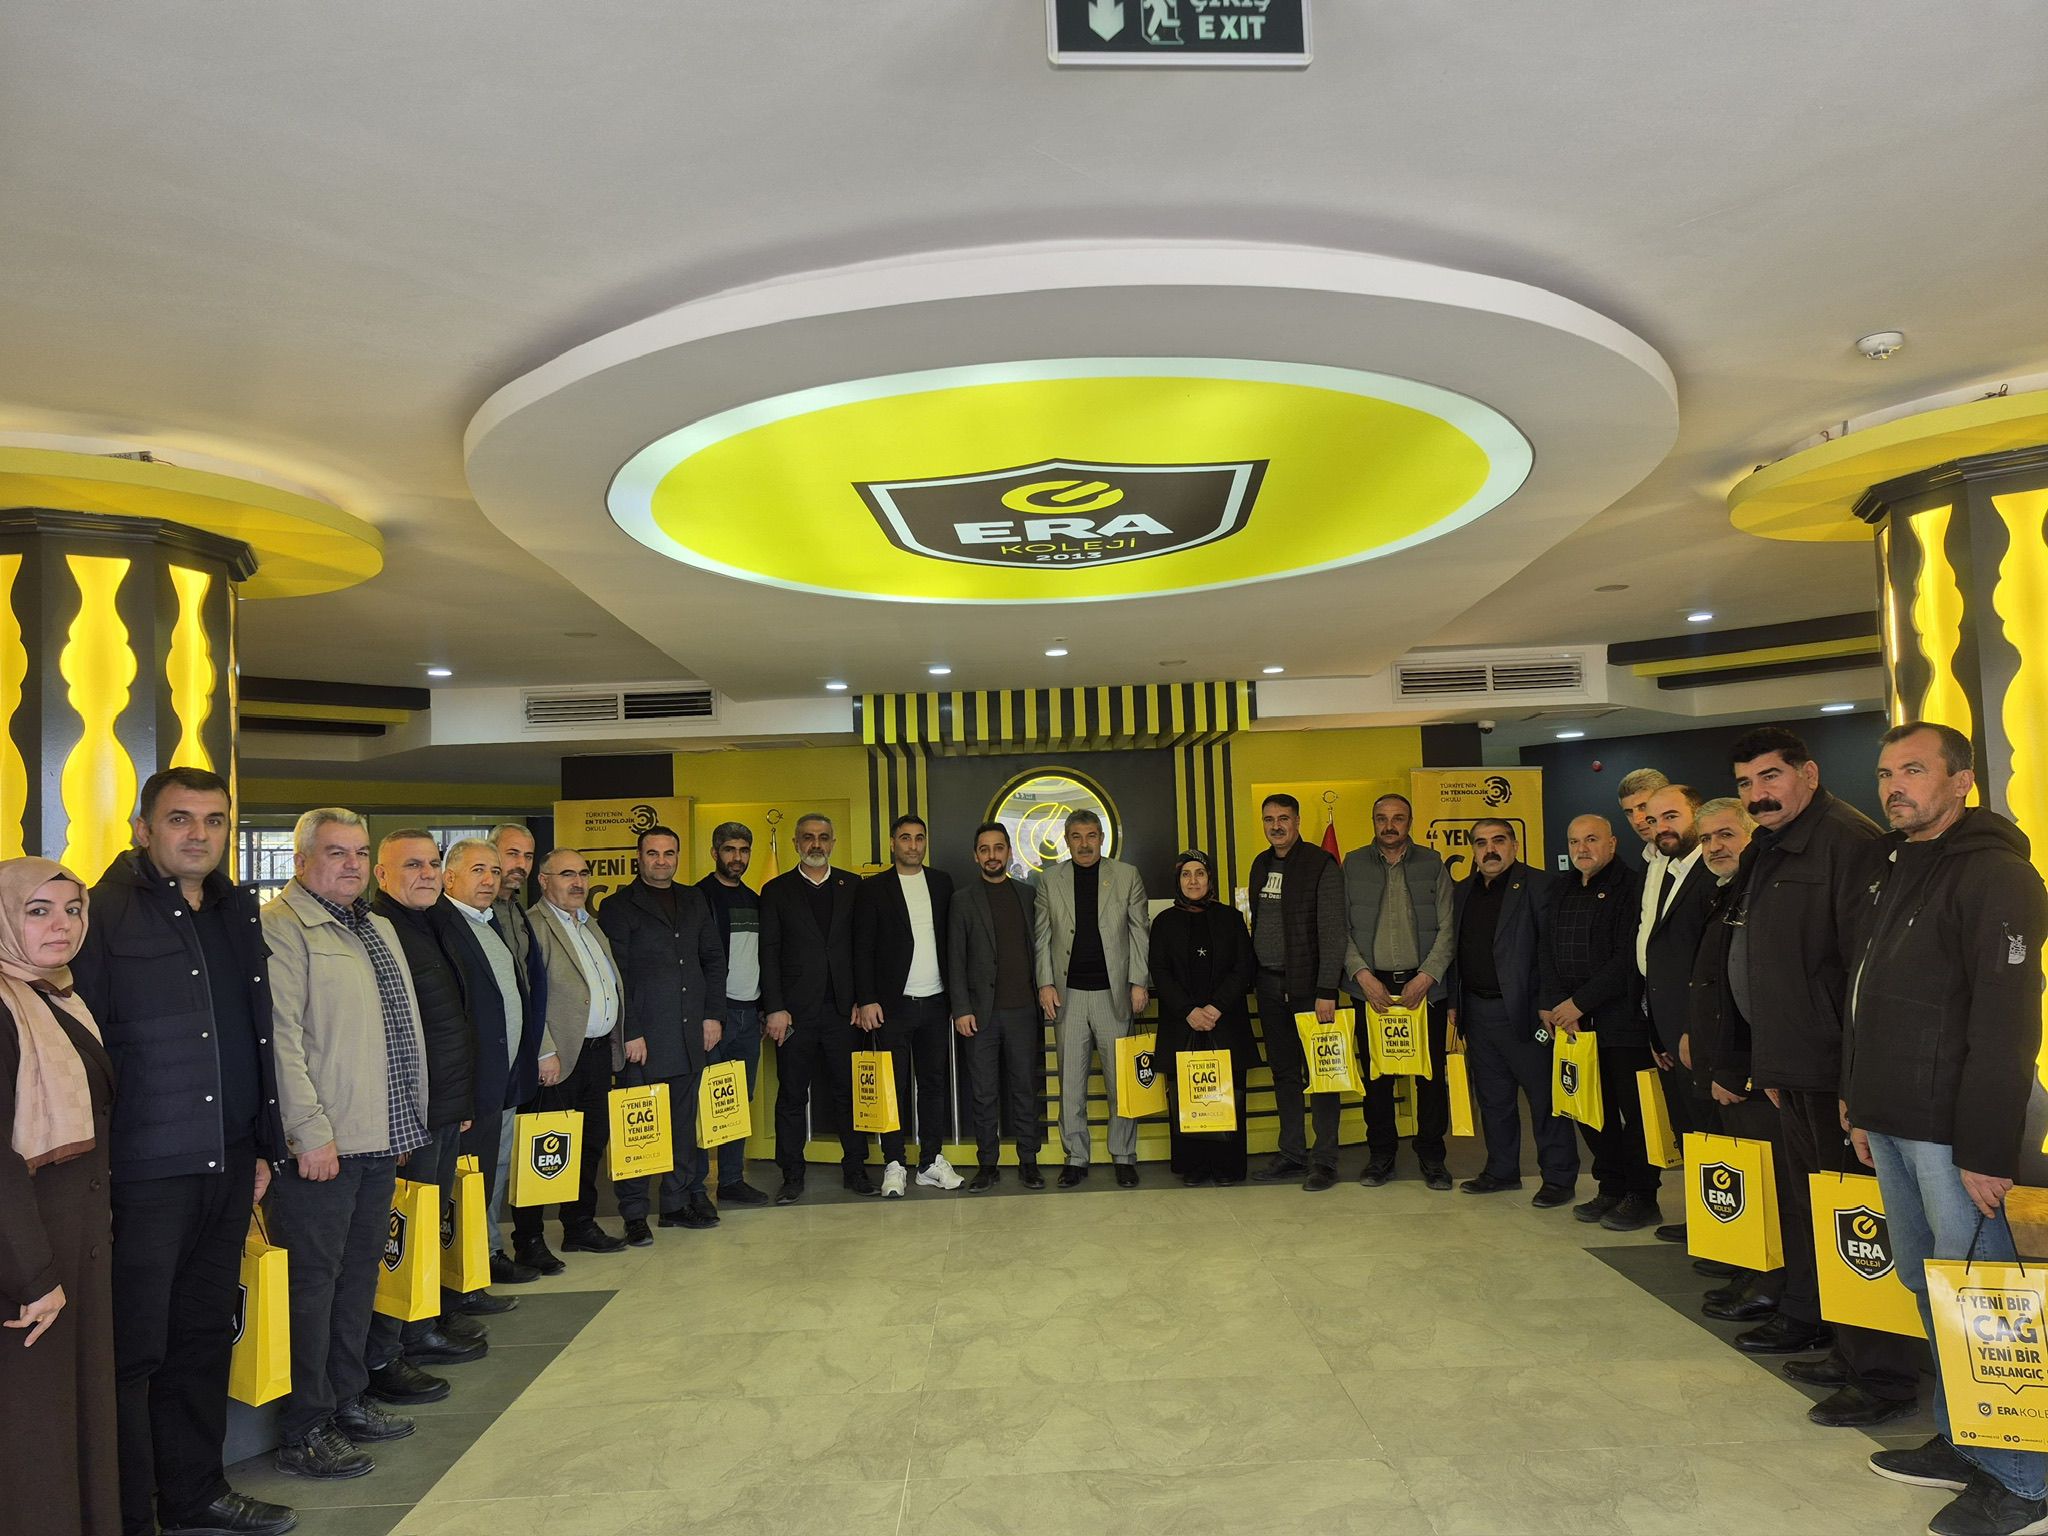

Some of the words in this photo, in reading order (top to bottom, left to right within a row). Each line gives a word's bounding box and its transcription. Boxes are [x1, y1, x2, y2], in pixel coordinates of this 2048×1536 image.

[1198, 15, 1266, 40] EXIT
[954, 514, 1174, 544] ERA
[1000, 538, 1136, 555] KOLEJİ
[1036, 551, 1102, 562] 2013
[1442, 830, 1472, 846] YEN
[585, 856, 625, 876] YENİ
[1384, 1025, 1409, 1039] ÇAĞ
[861, 1072, 874, 1086] ÇAĞ
[1140, 1068, 1153, 1079] ERA
[1192, 1070, 1216, 1085] ÇAĞ
[1563, 1074, 1572, 1086] ER
[713, 1084, 734, 1100] ÇAĞ
[626, 1108, 654, 1127] ÇAĞ
[628, 1126, 642, 1134] YENİ
[538, 1154, 562, 1167] ERA
[1708, 1189, 1736, 1207] ERA
[1847, 1240, 1886, 1261] ERA
[1970, 1294, 2003, 1310] YENİ
[2006, 1295, 2031, 1311] BİR
[1973, 1313, 2038, 1345] ÇAĞ
[1978, 1346, 2012, 1362] YENİ
[2015, 1347, 2041, 1364] BİR
[1980, 1365, 2044, 1381] BAŞLANGIÇ
